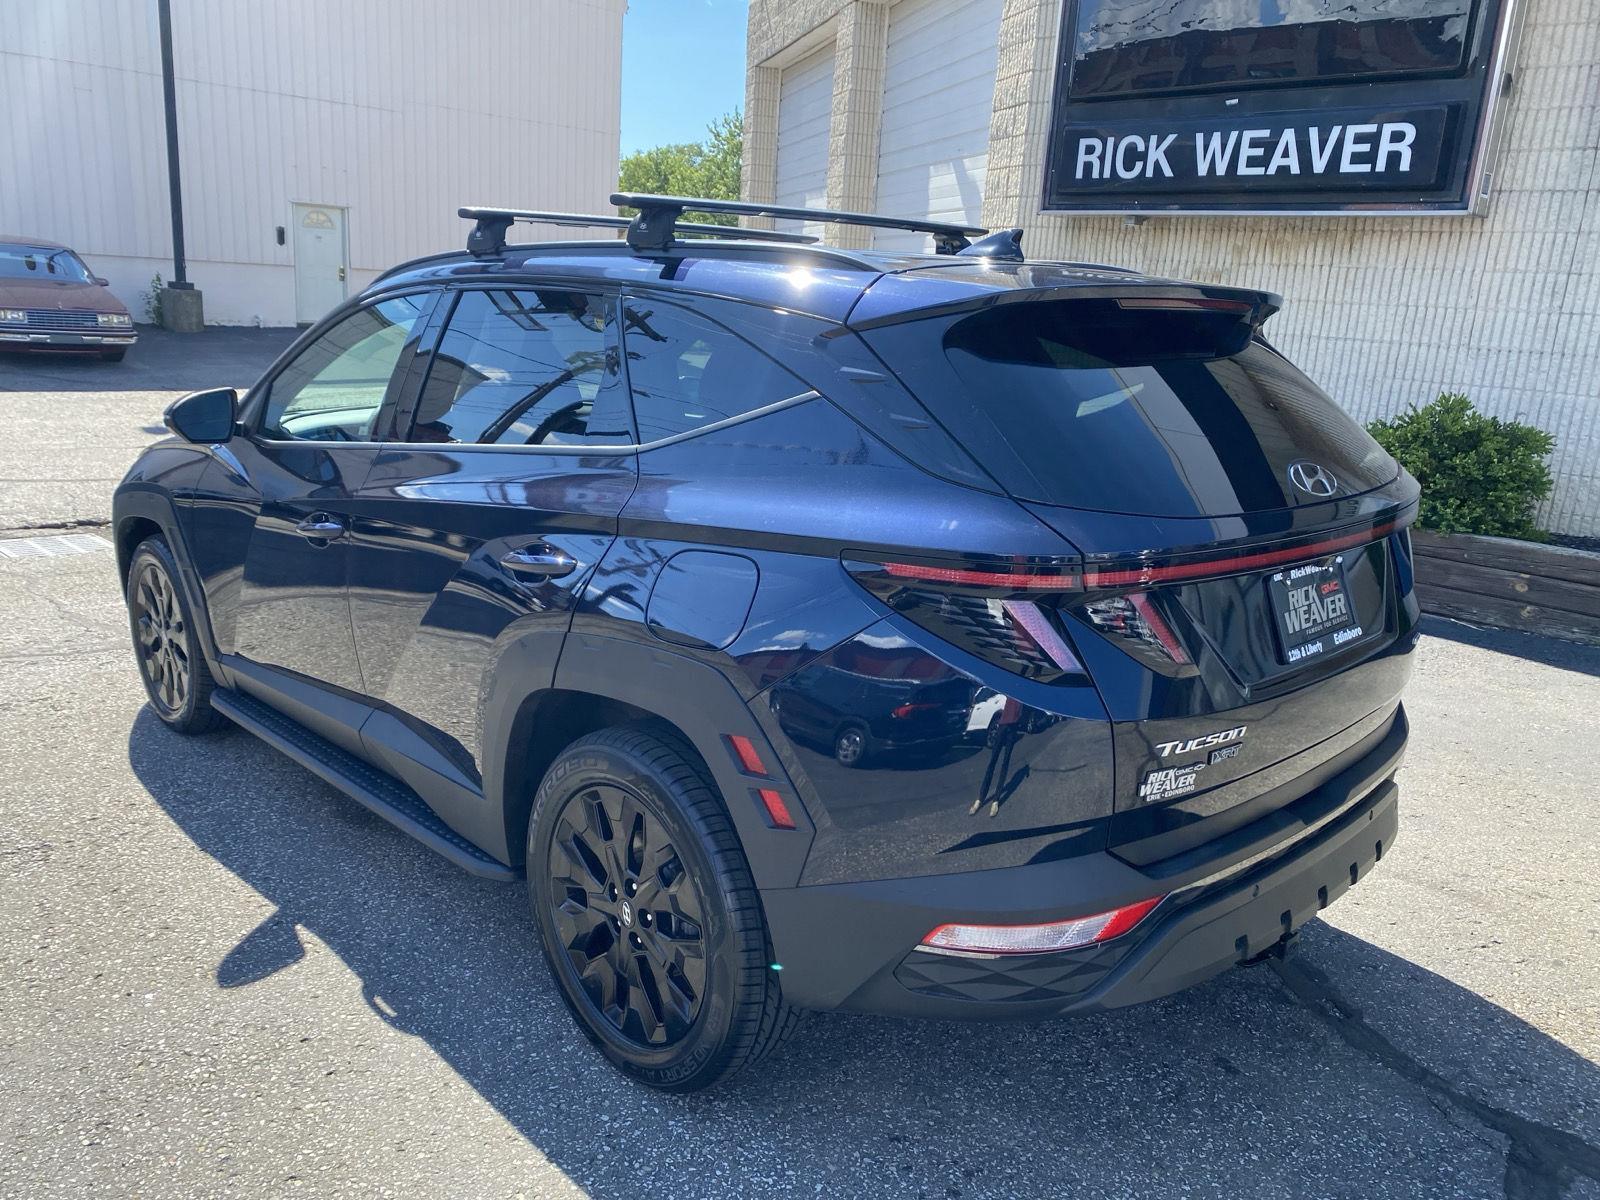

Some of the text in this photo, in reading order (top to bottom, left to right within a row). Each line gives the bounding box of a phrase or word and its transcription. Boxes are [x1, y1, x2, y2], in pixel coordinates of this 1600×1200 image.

[1075, 122, 1417, 180] RICK WEAVER
[1288, 584, 1317, 610] RICK
[1284, 593, 1347, 634] WEAVER
[1333, 626, 1363, 645] Edinboro
[1139, 773, 1197, 797] WEAVER
[1148, 768, 1178, 784] RICK
[1165, 785, 1195, 798] EDINBORO
